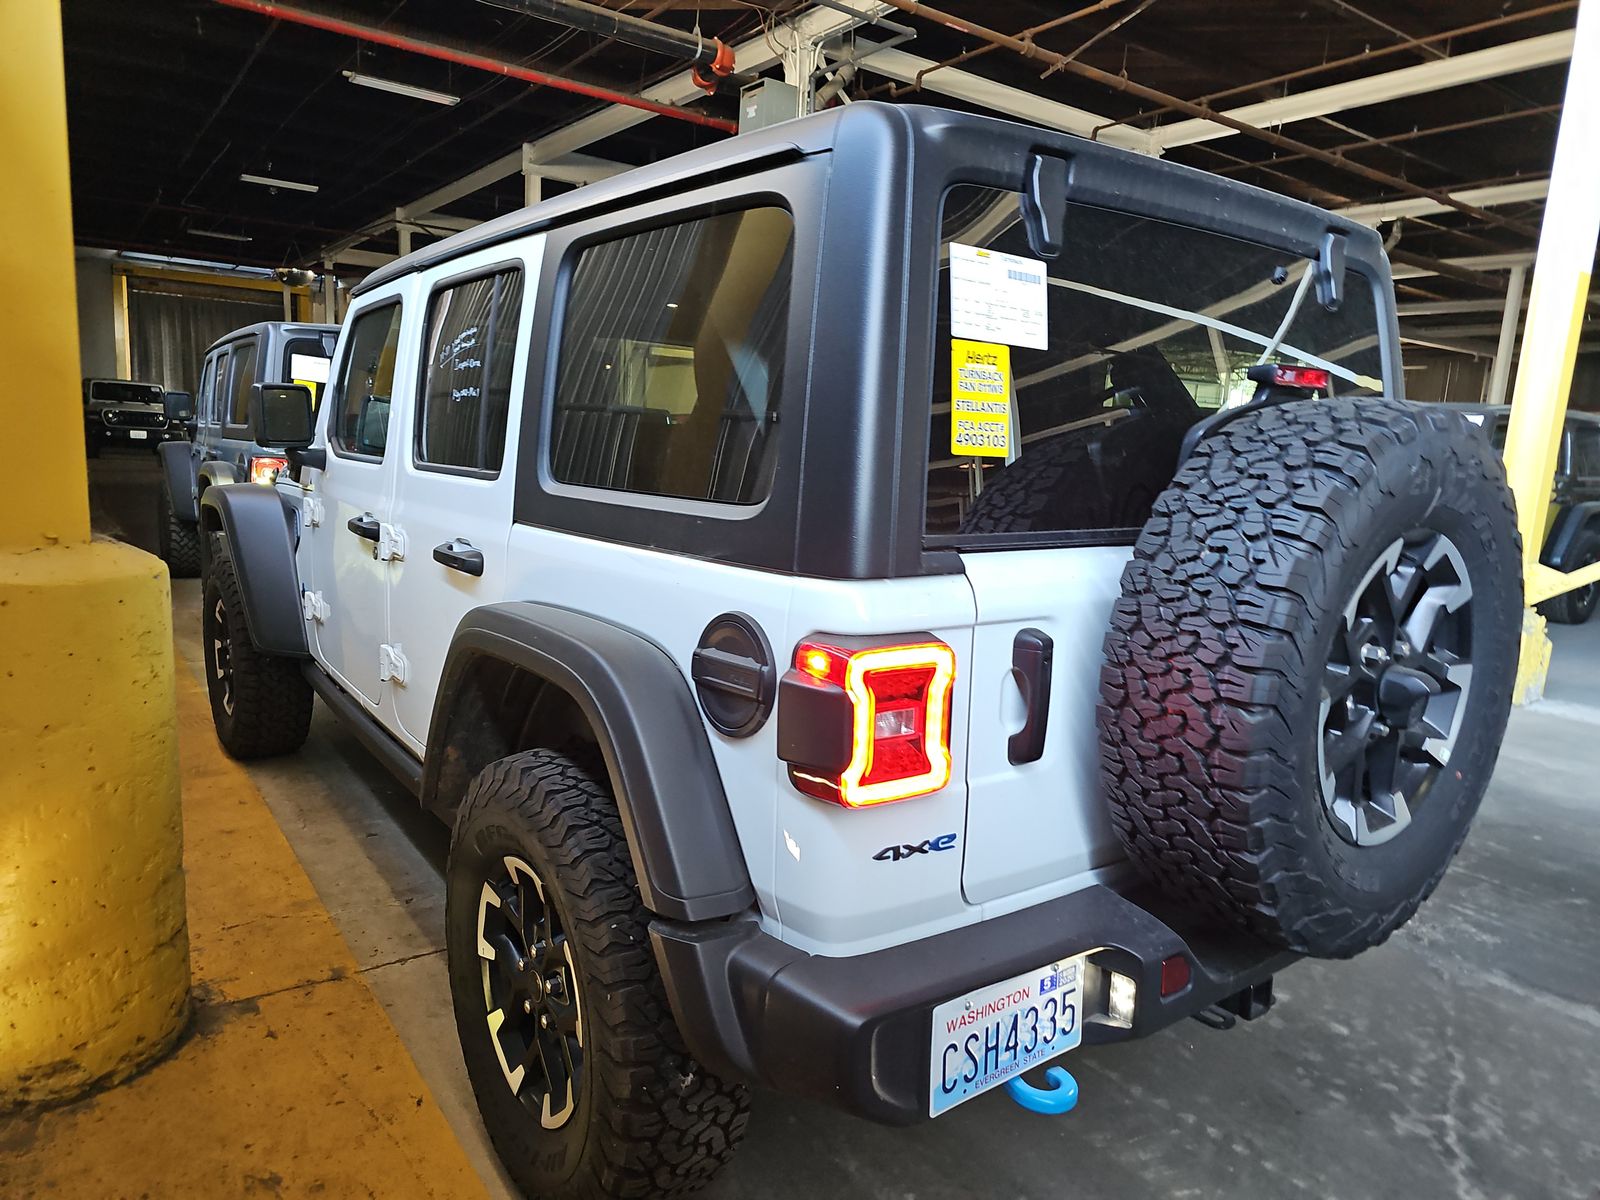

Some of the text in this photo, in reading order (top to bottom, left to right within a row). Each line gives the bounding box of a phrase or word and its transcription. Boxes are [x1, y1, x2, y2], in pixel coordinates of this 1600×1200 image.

[966, 350, 998, 366] Hertz
[958, 368, 1004, 382] TURNBACK
[955, 400, 1007, 413] STELLANTIS
[956, 433, 1007, 447] 4903103
[946, 986, 1031, 1034] WASHINGTON
[941, 988, 1077, 1094] CSH4335
[975, 1049, 1046, 1089] EVERGREEN STATE
